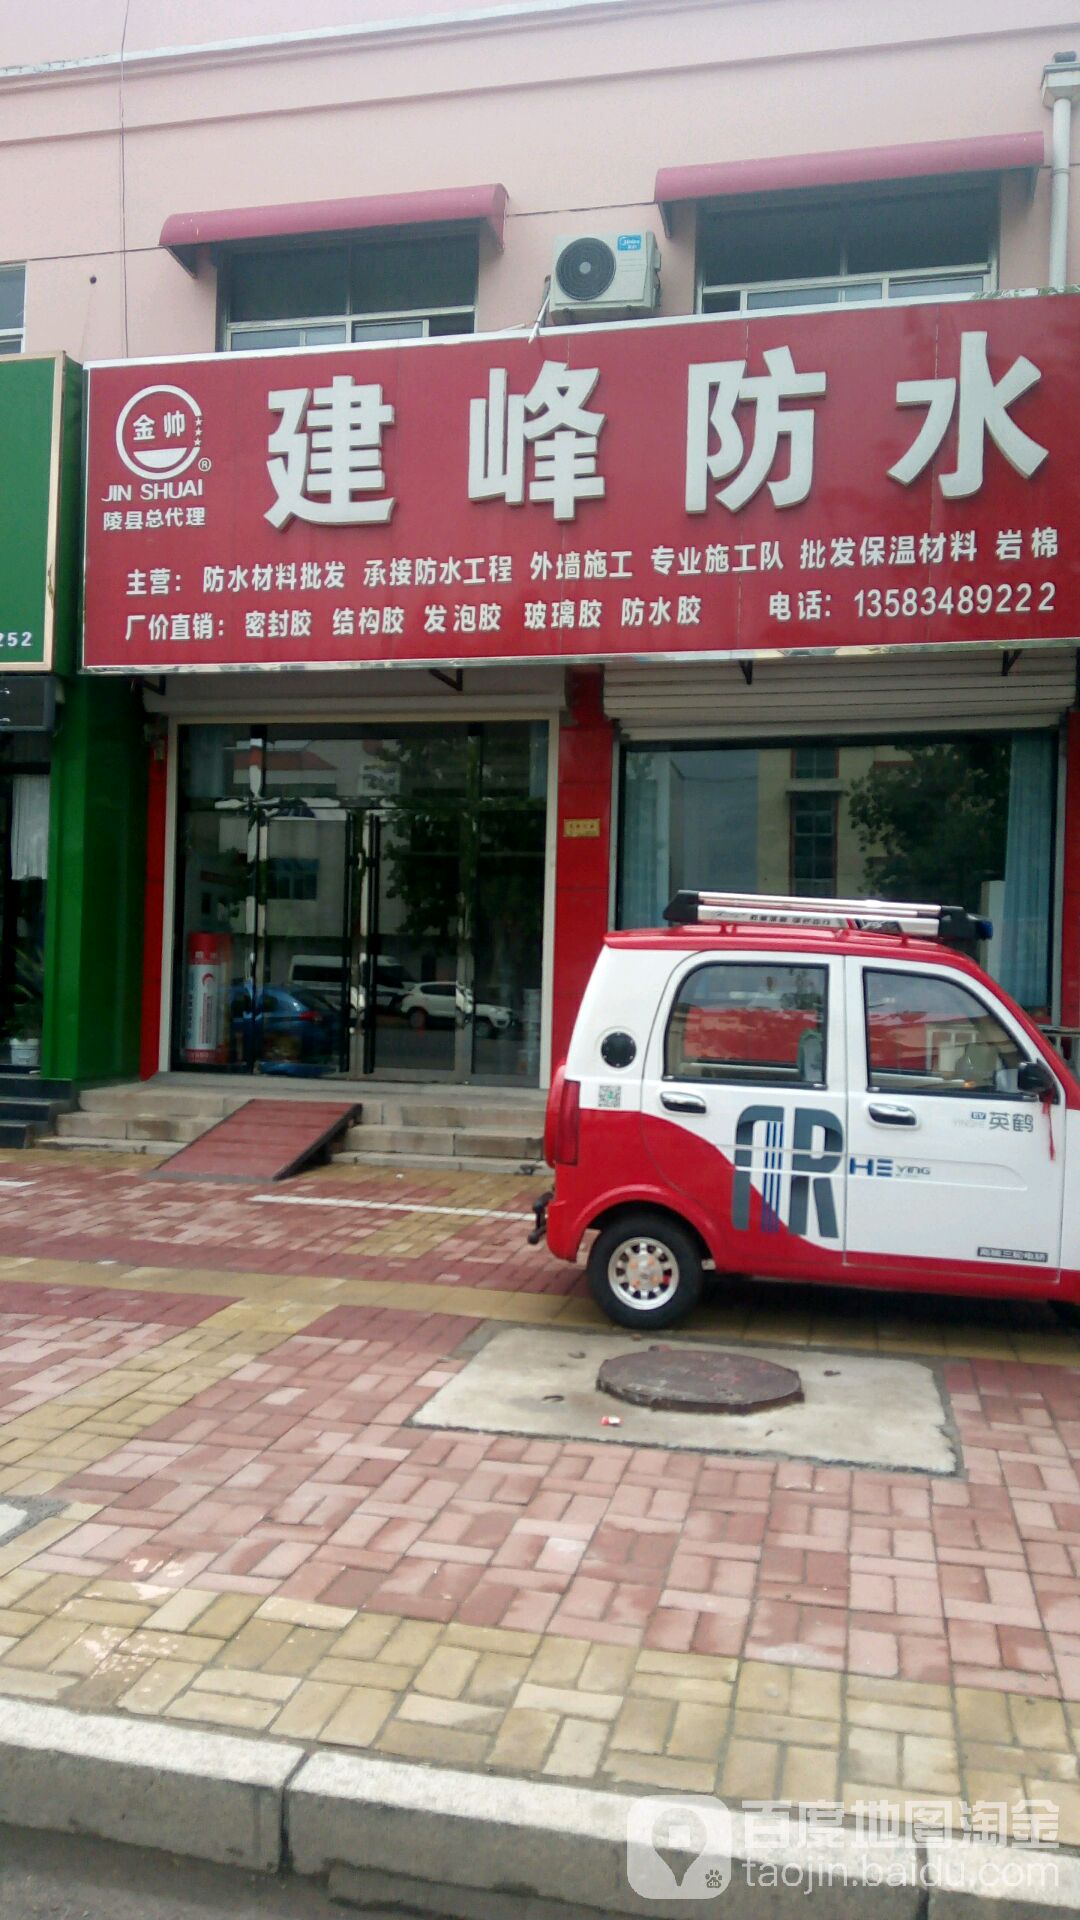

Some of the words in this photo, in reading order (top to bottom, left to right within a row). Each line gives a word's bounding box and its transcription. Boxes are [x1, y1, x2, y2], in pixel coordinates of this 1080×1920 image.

[132, 410, 186, 441] 金帅
[263, 330, 1049, 530] 建峰防水
[101, 484, 132, 502] JIN
[140, 479, 203, 501] SHUAI
[103, 507, 206, 531] 陵县总代理
[202, 564, 346, 593] 防水材料批发
[363, 554, 513, 588] 承接防水工程
[529, 549, 633, 581] 外墙施工
[650, 540, 784, 576] 专业施工队
[799, 530, 977, 570] 批发保温材料
[995, 526, 1058, 560] 岩棉
[245, 609, 312, 638] 密封胶
[332, 606, 405, 636] 结构胶
[423, 602, 502, 633] 发泡胶
[524, 598, 602, 630] 玻璃胶
[621, 595, 701, 627] 防水胶
[853, 582, 1056, 618] 13583489222
[989, 1111, 1035, 1133] 英鹤
